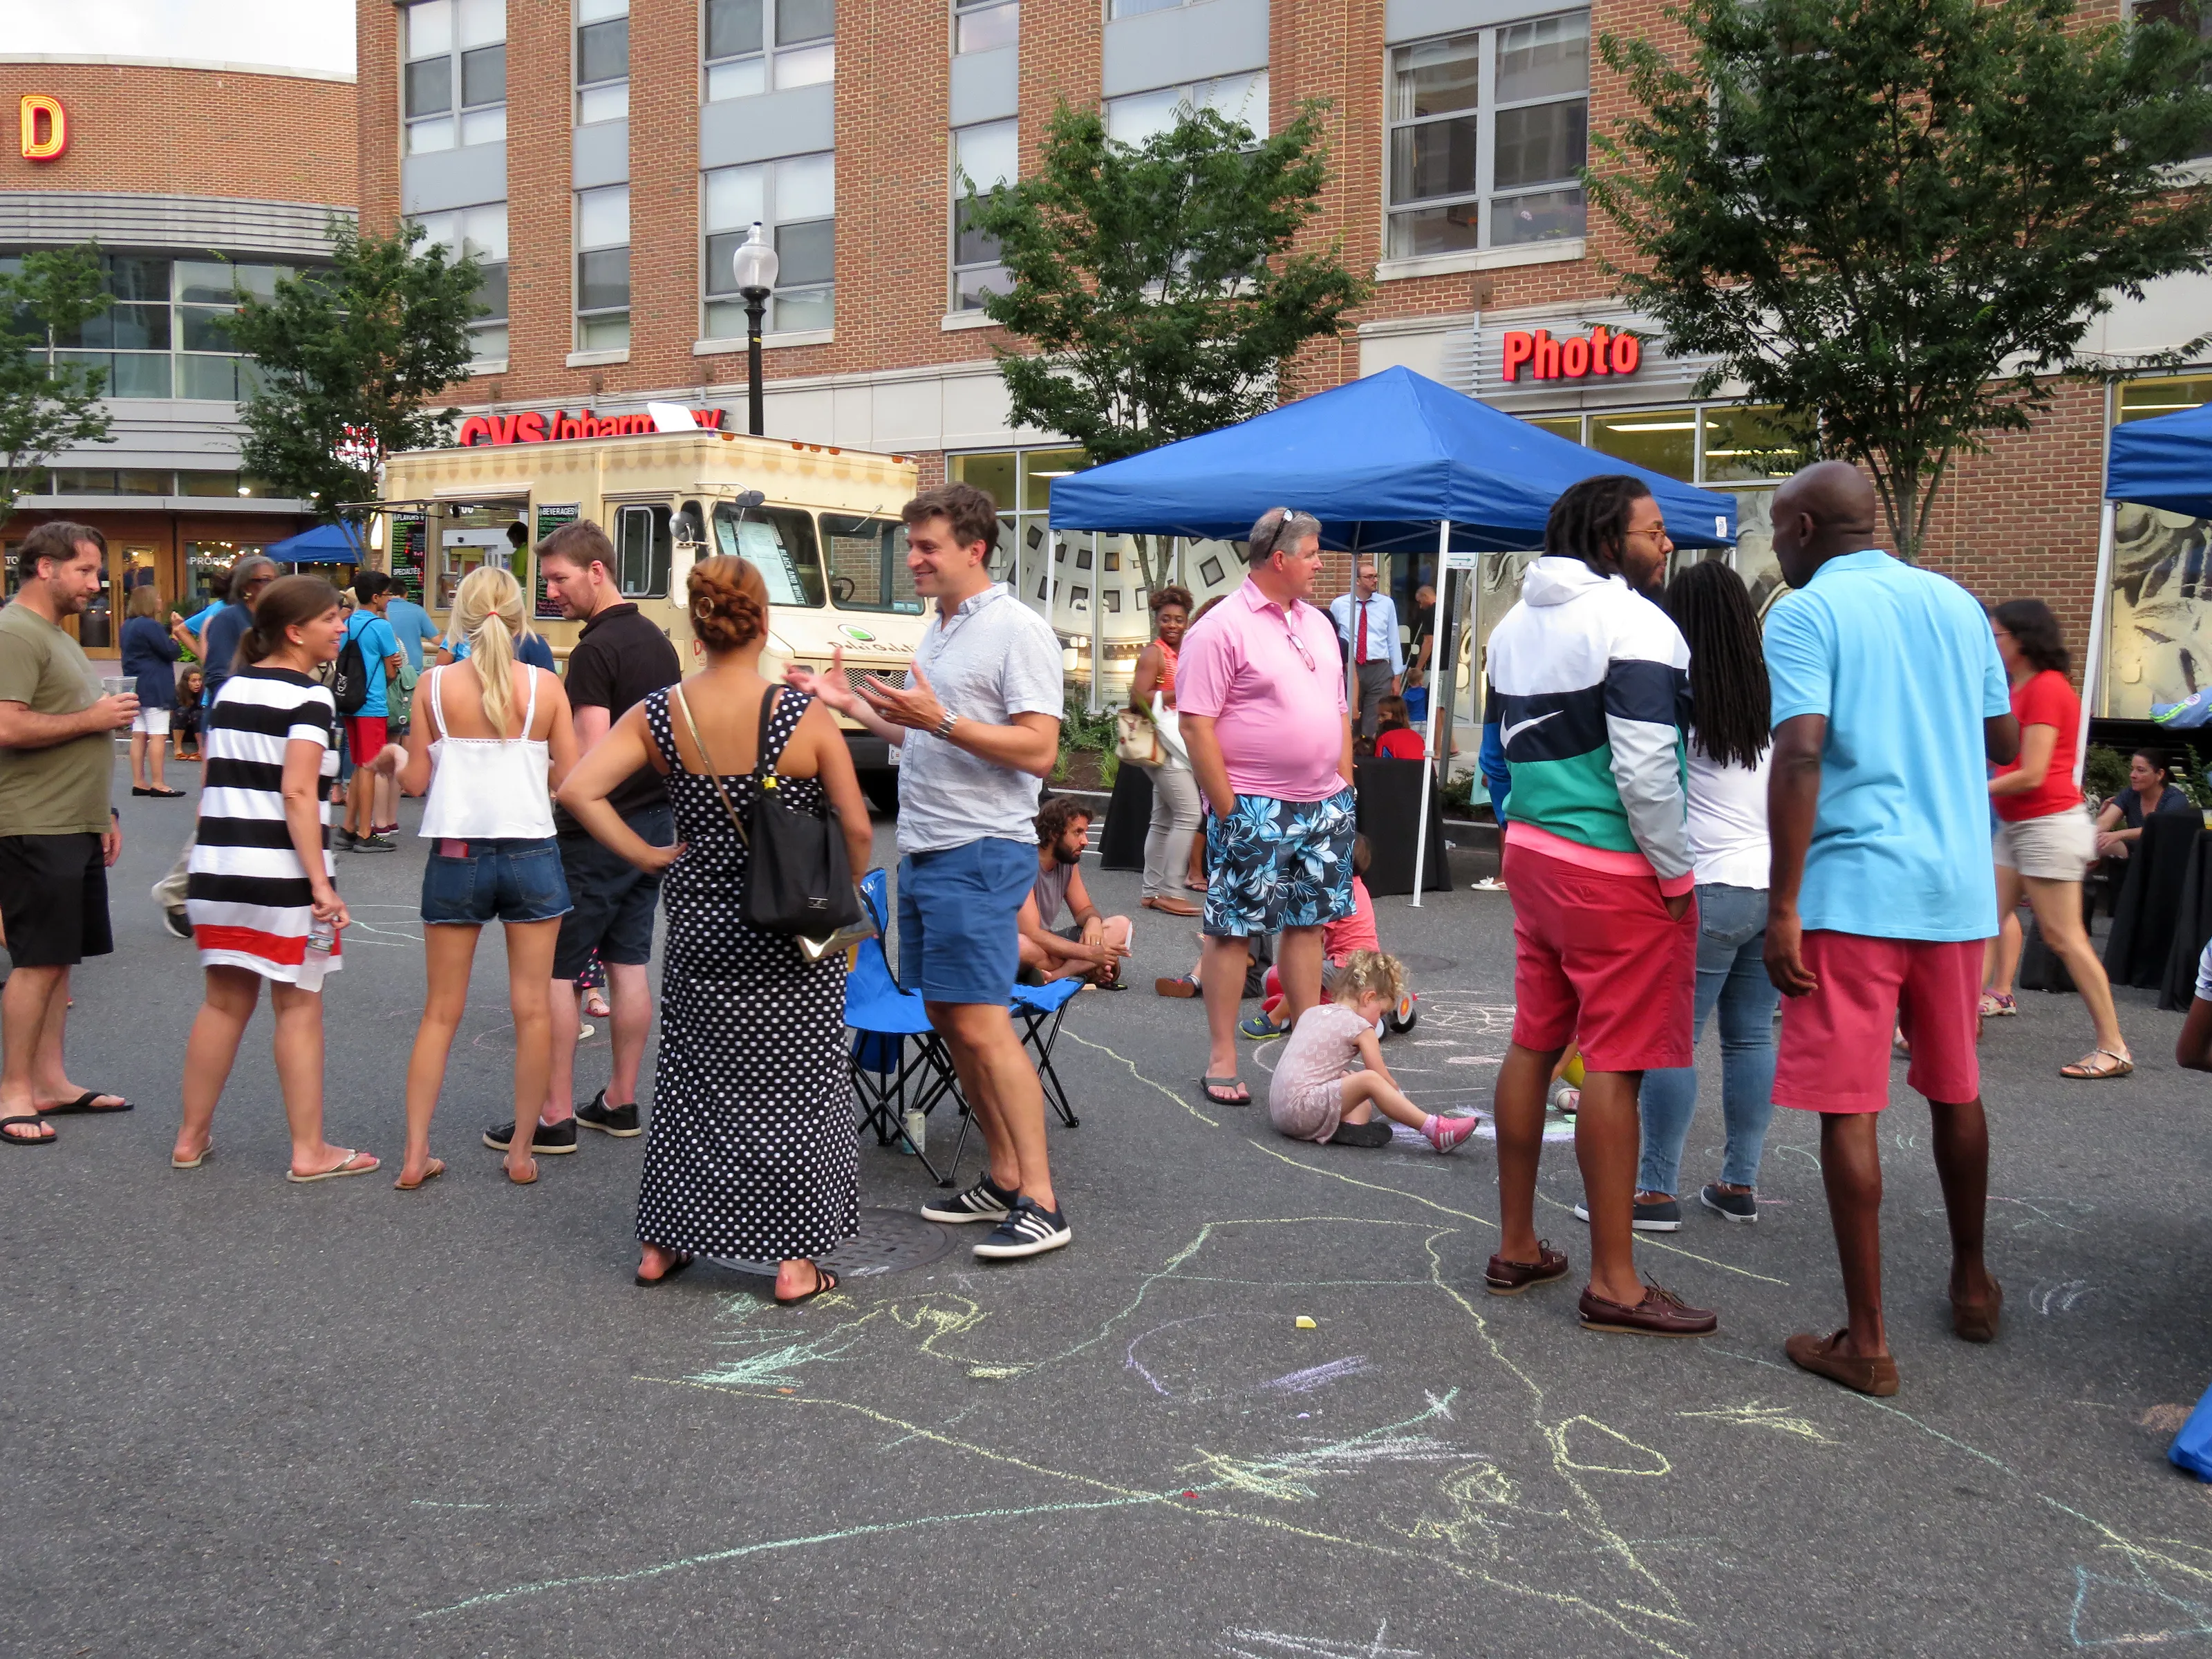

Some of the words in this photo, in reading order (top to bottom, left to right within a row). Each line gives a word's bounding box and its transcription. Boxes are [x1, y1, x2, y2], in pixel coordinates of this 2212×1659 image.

[20, 95, 67, 160] D
[1503, 326, 1639, 382] Photo
[397, 513, 420, 521] FLAVORS
[543, 507, 575, 516] BEVERAGES
[779, 549, 792, 569] BLACK
[393, 568, 421, 576] SPECIALTIES
[787, 568, 798, 584] AND
[792, 585, 806, 605] WHITE
